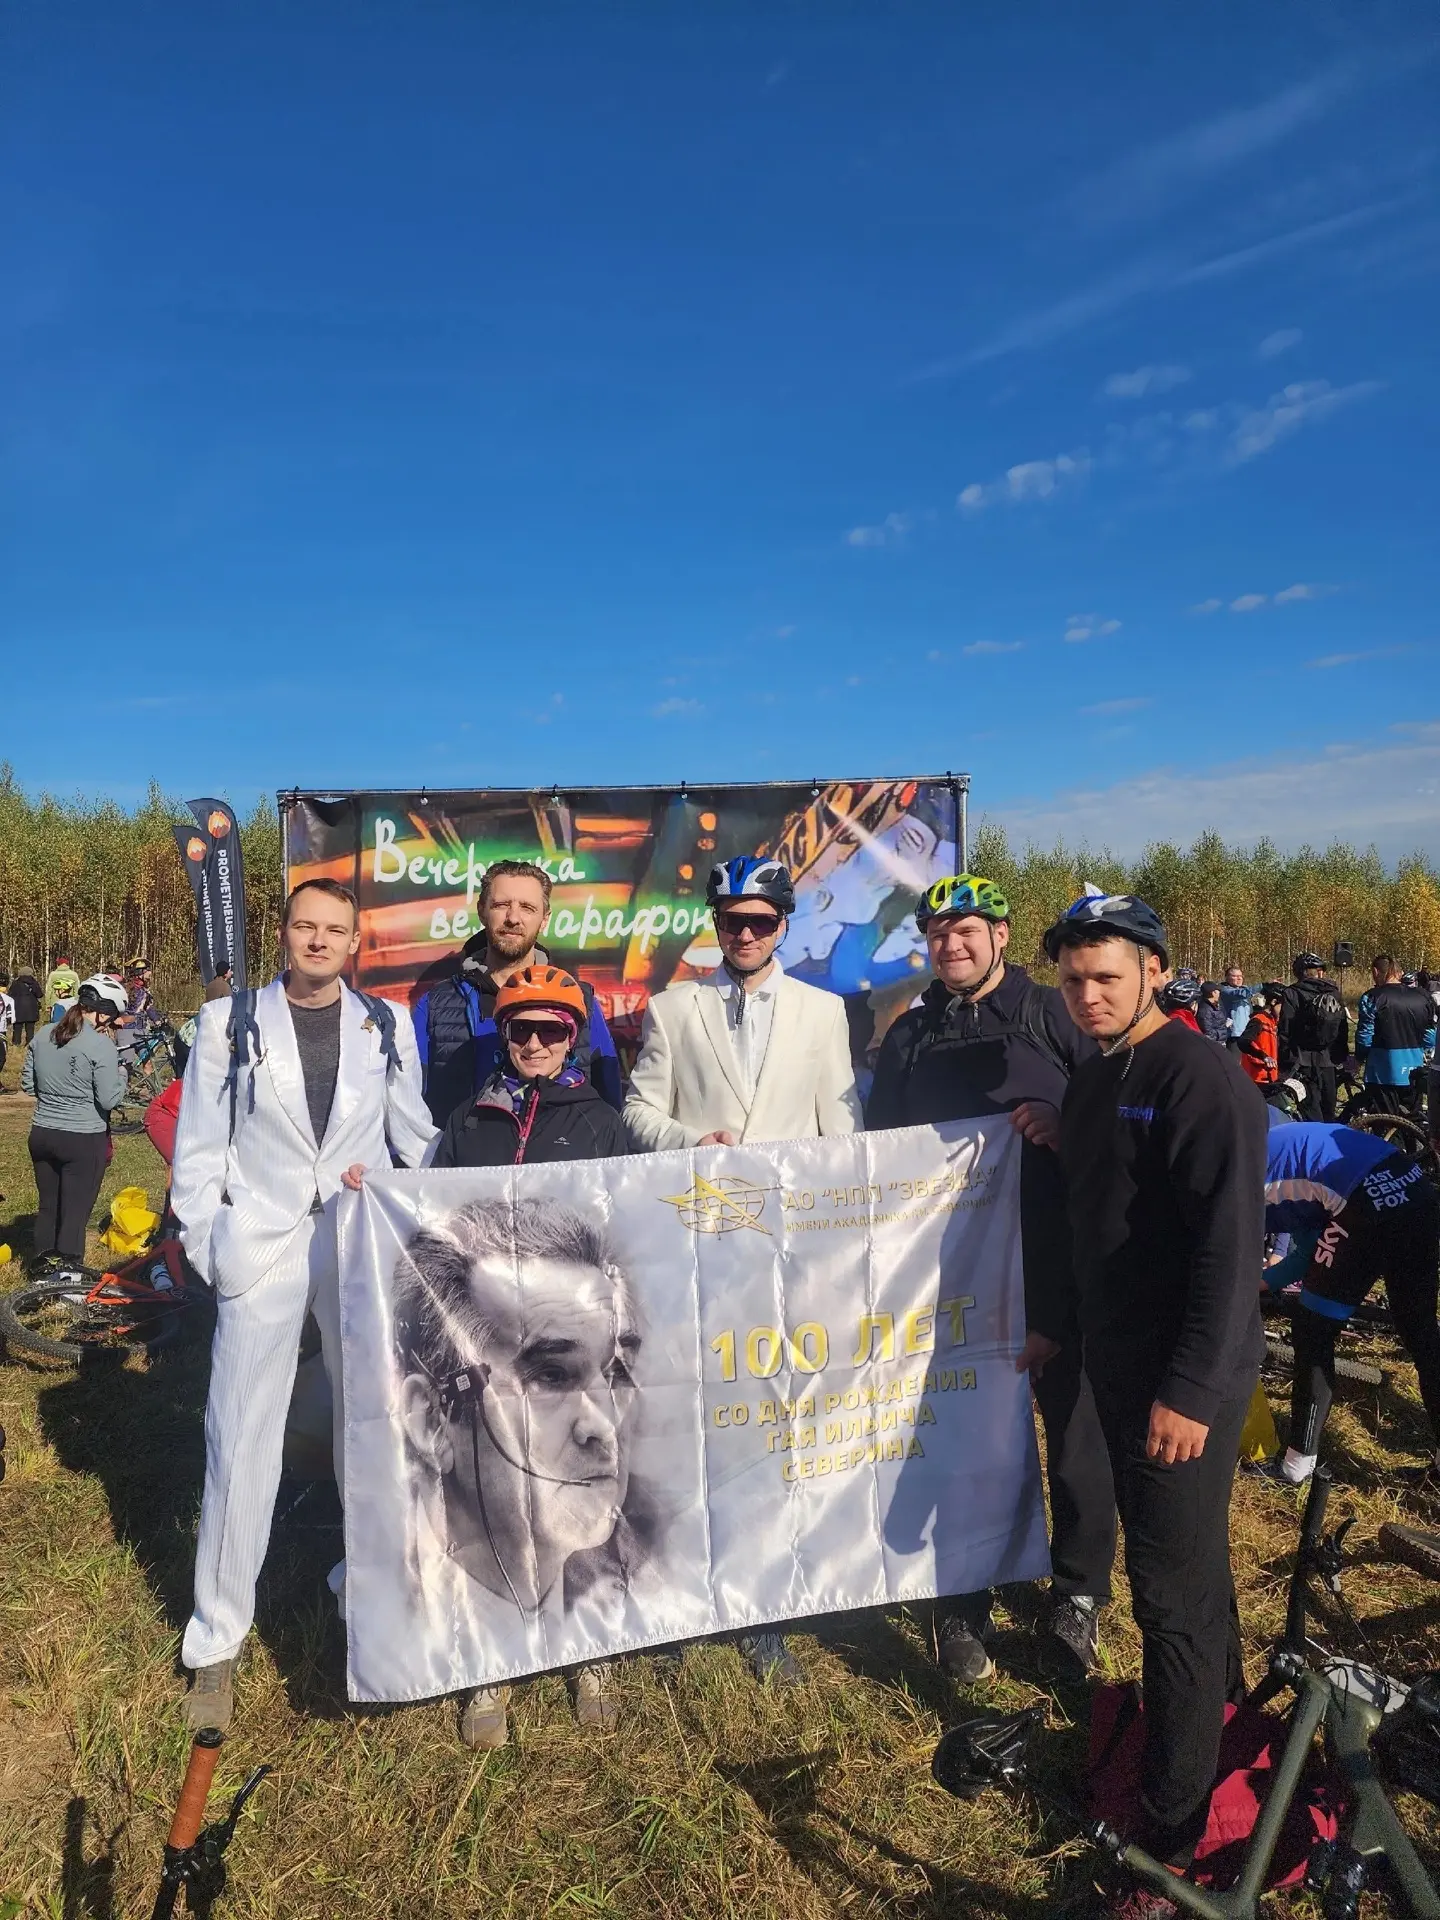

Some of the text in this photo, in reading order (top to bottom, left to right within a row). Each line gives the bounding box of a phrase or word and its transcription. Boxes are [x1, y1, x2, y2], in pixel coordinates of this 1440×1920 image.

[1363, 1169, 1395, 1187] 21ST
[784, 1188, 815, 1212] АО
[1372, 1190, 1410, 1212] FOX
[785, 1218, 830, 1234] ИМЕНИ
[709, 1295, 976, 1382] 100 ЛЕТ
[713, 1367, 977, 1427] СО ДНЯ РОЖДЕНИЯ
[766, 1403, 937, 1453] ГАЯ ИЛЬИЧА
[781, 1435, 925, 1482] СЕВЕРИНА
